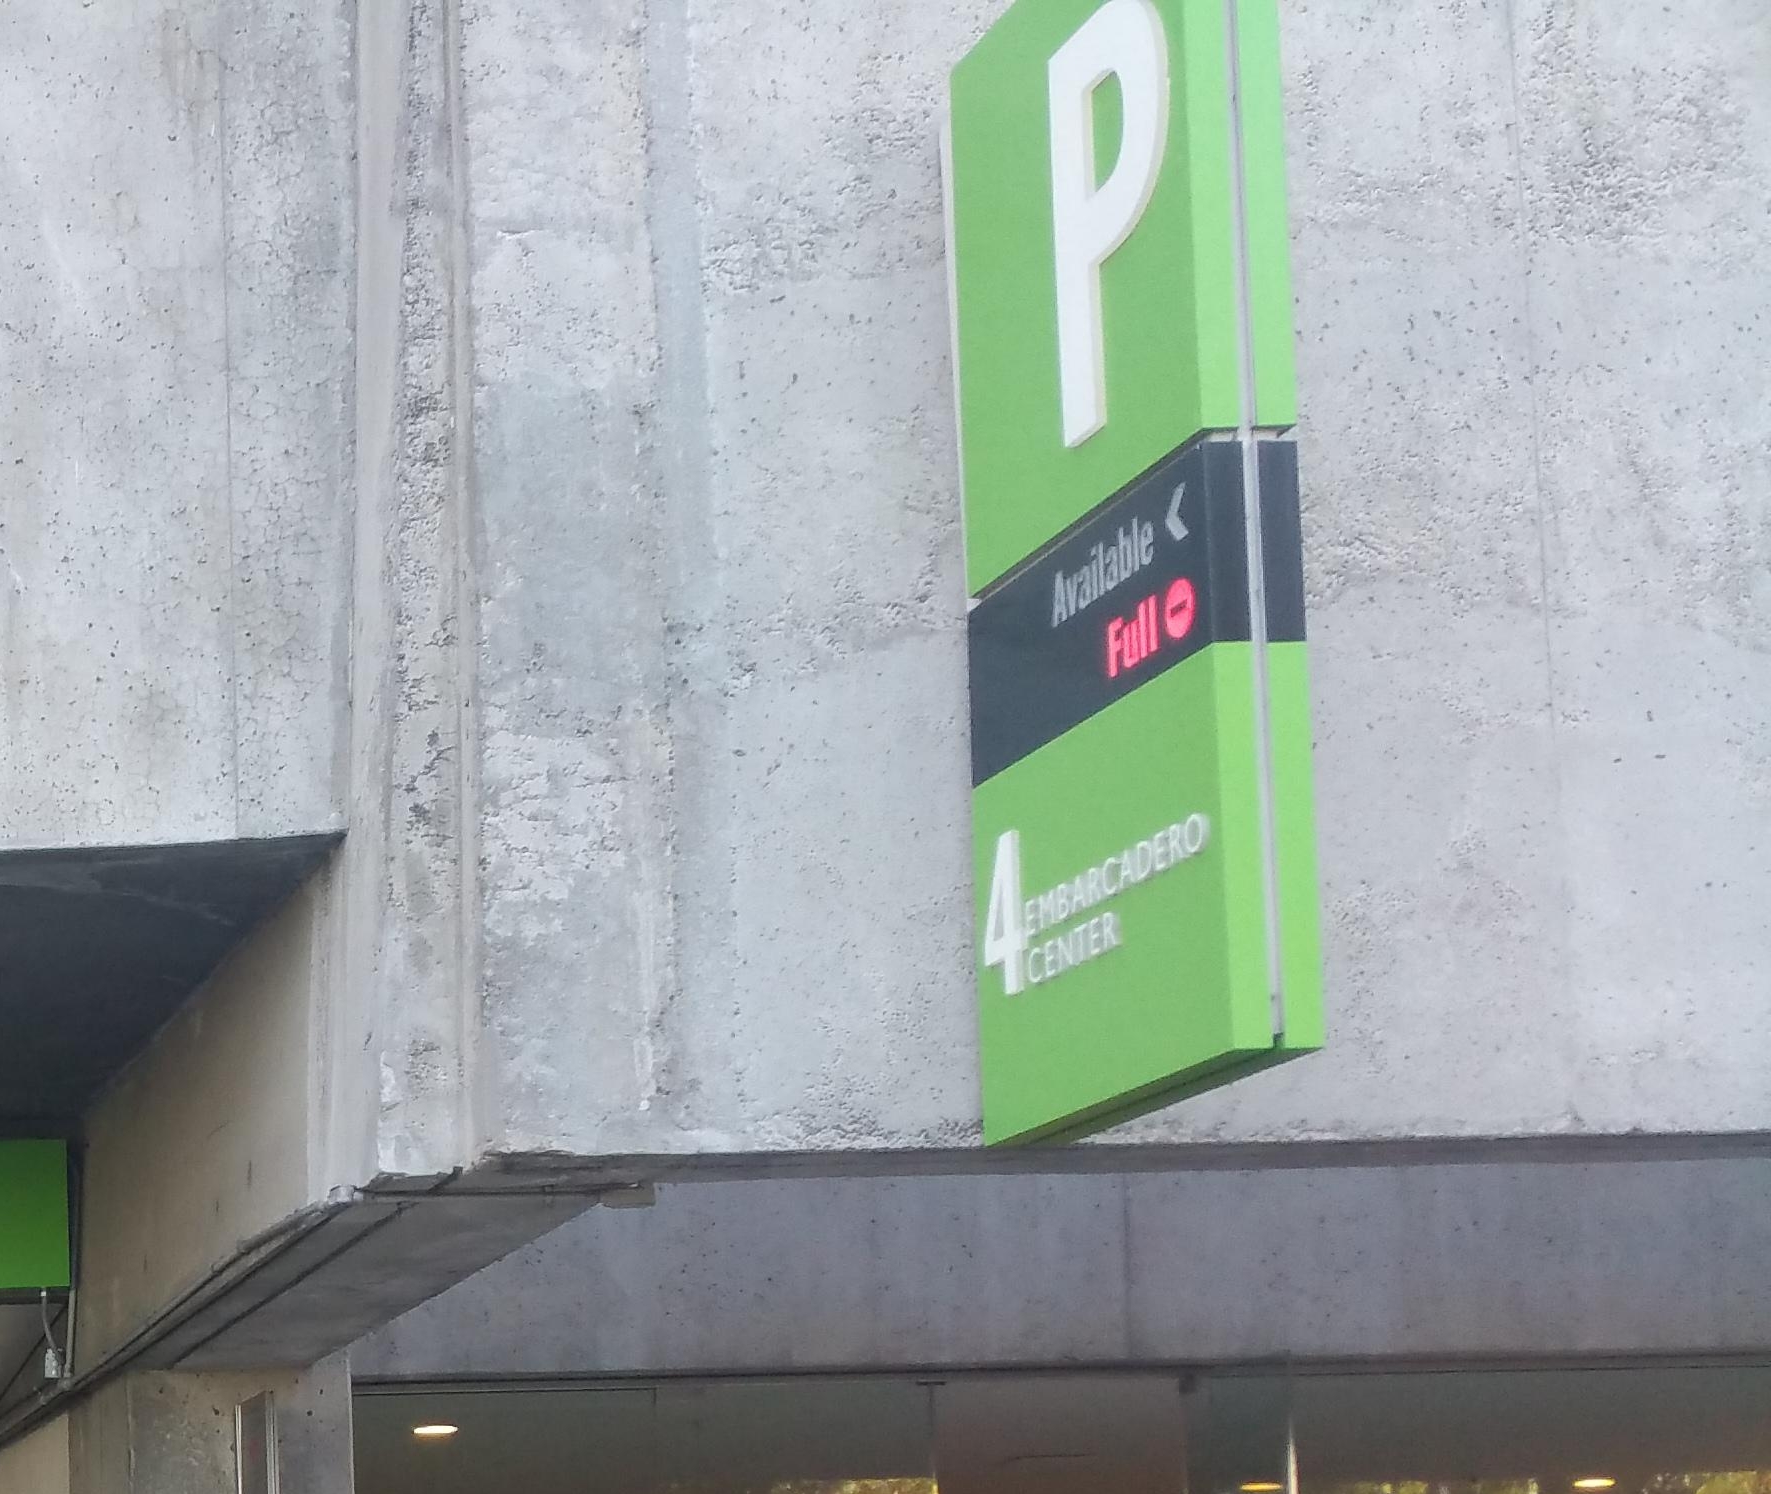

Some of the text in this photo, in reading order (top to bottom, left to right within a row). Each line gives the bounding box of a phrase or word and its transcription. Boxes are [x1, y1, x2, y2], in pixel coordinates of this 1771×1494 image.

[1049, 0, 1169, 446] P
[1052, 516, 1154, 628] Available
[1107, 594, 1159, 678] Full
[984, 813, 1209, 995] 4 EMBARCADERO
[1029, 911, 1121, 983] CENTER
